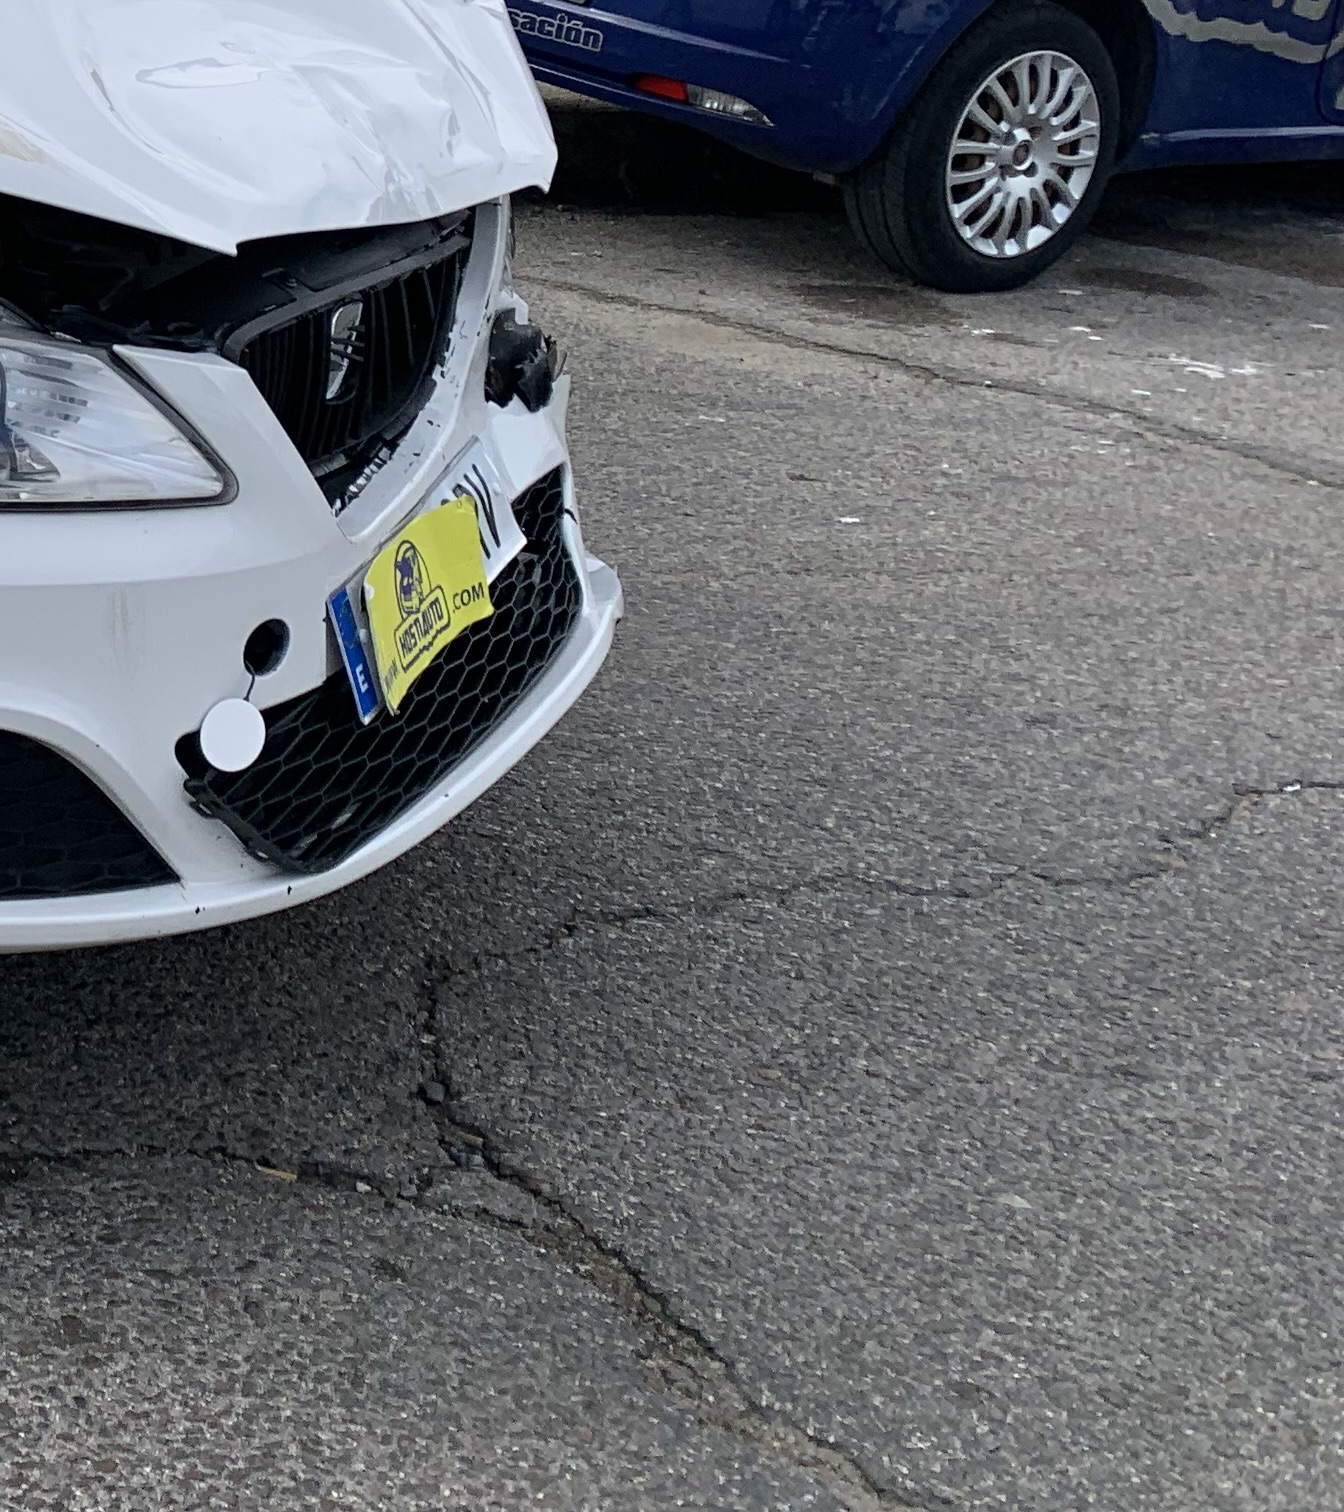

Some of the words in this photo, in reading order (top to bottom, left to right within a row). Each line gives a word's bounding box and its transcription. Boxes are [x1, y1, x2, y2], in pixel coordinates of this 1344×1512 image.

[398, 596, 444, 660] HOSTIAUTO
[452, 581, 485, 614] .COM
[355, 664, 368, 693] E
